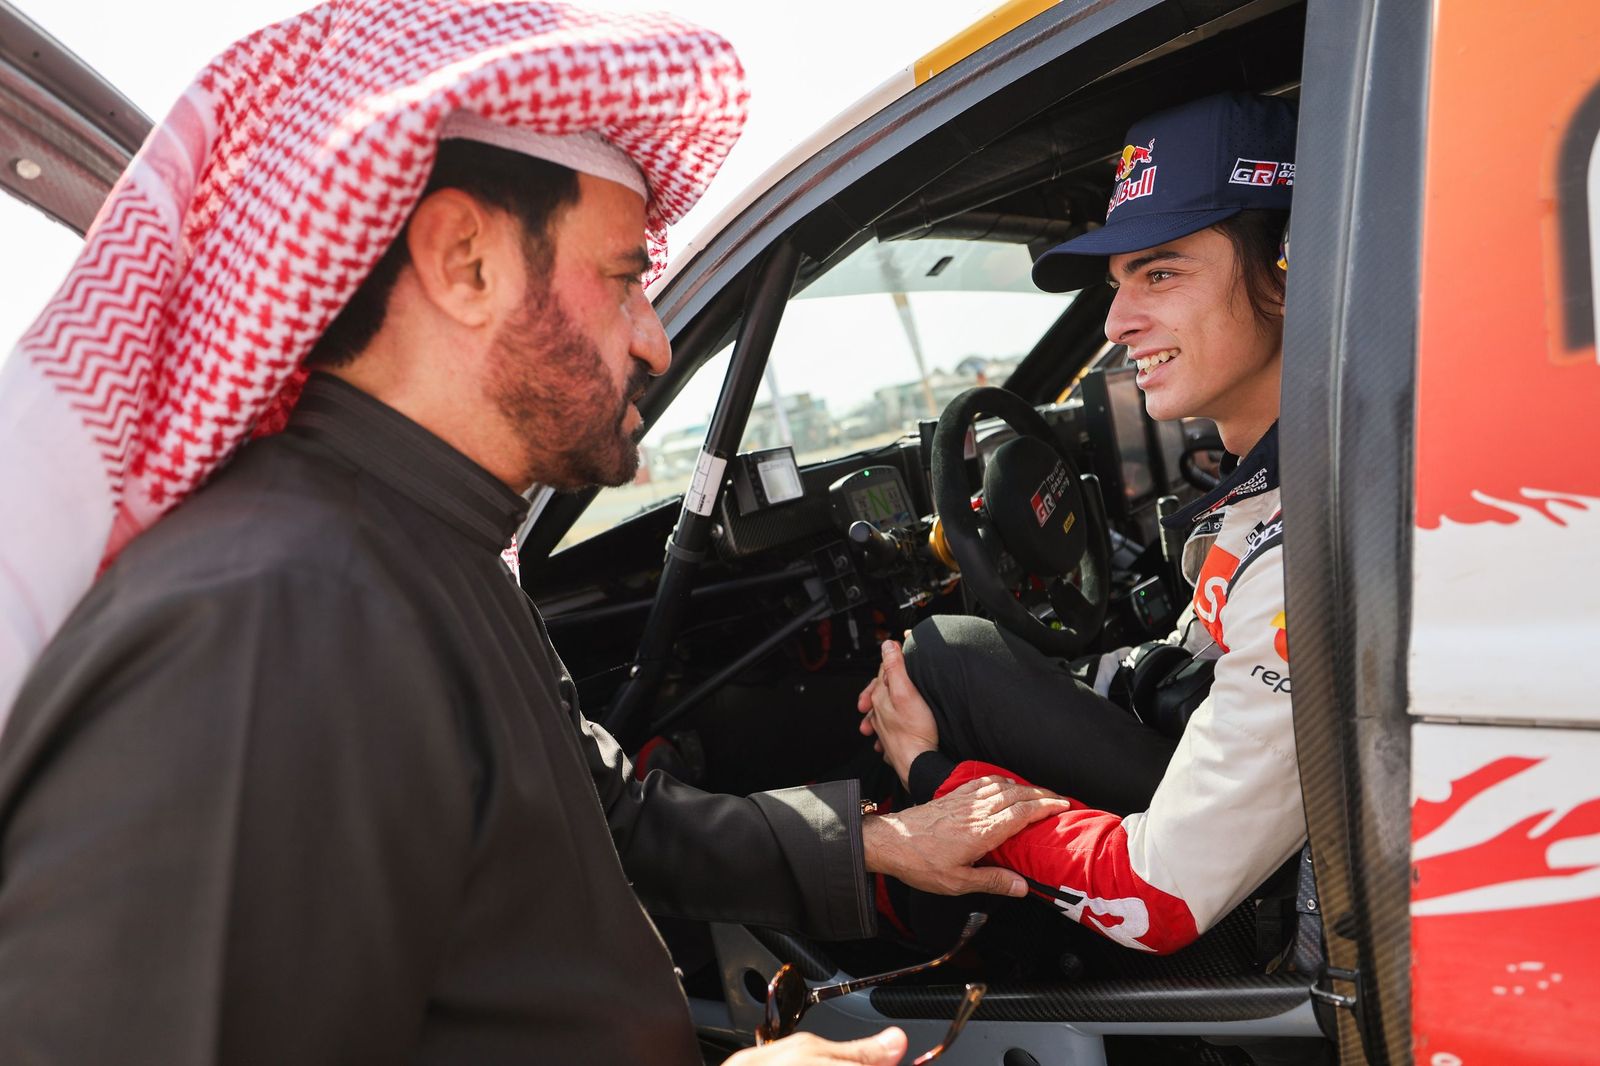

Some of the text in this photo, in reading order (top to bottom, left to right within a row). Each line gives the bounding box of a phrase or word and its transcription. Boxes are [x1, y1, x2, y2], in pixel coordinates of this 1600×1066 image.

[1117, 165, 1157, 207] Bull
[1234, 169, 1274, 184] GR
[1037, 493, 1055, 524] GR
